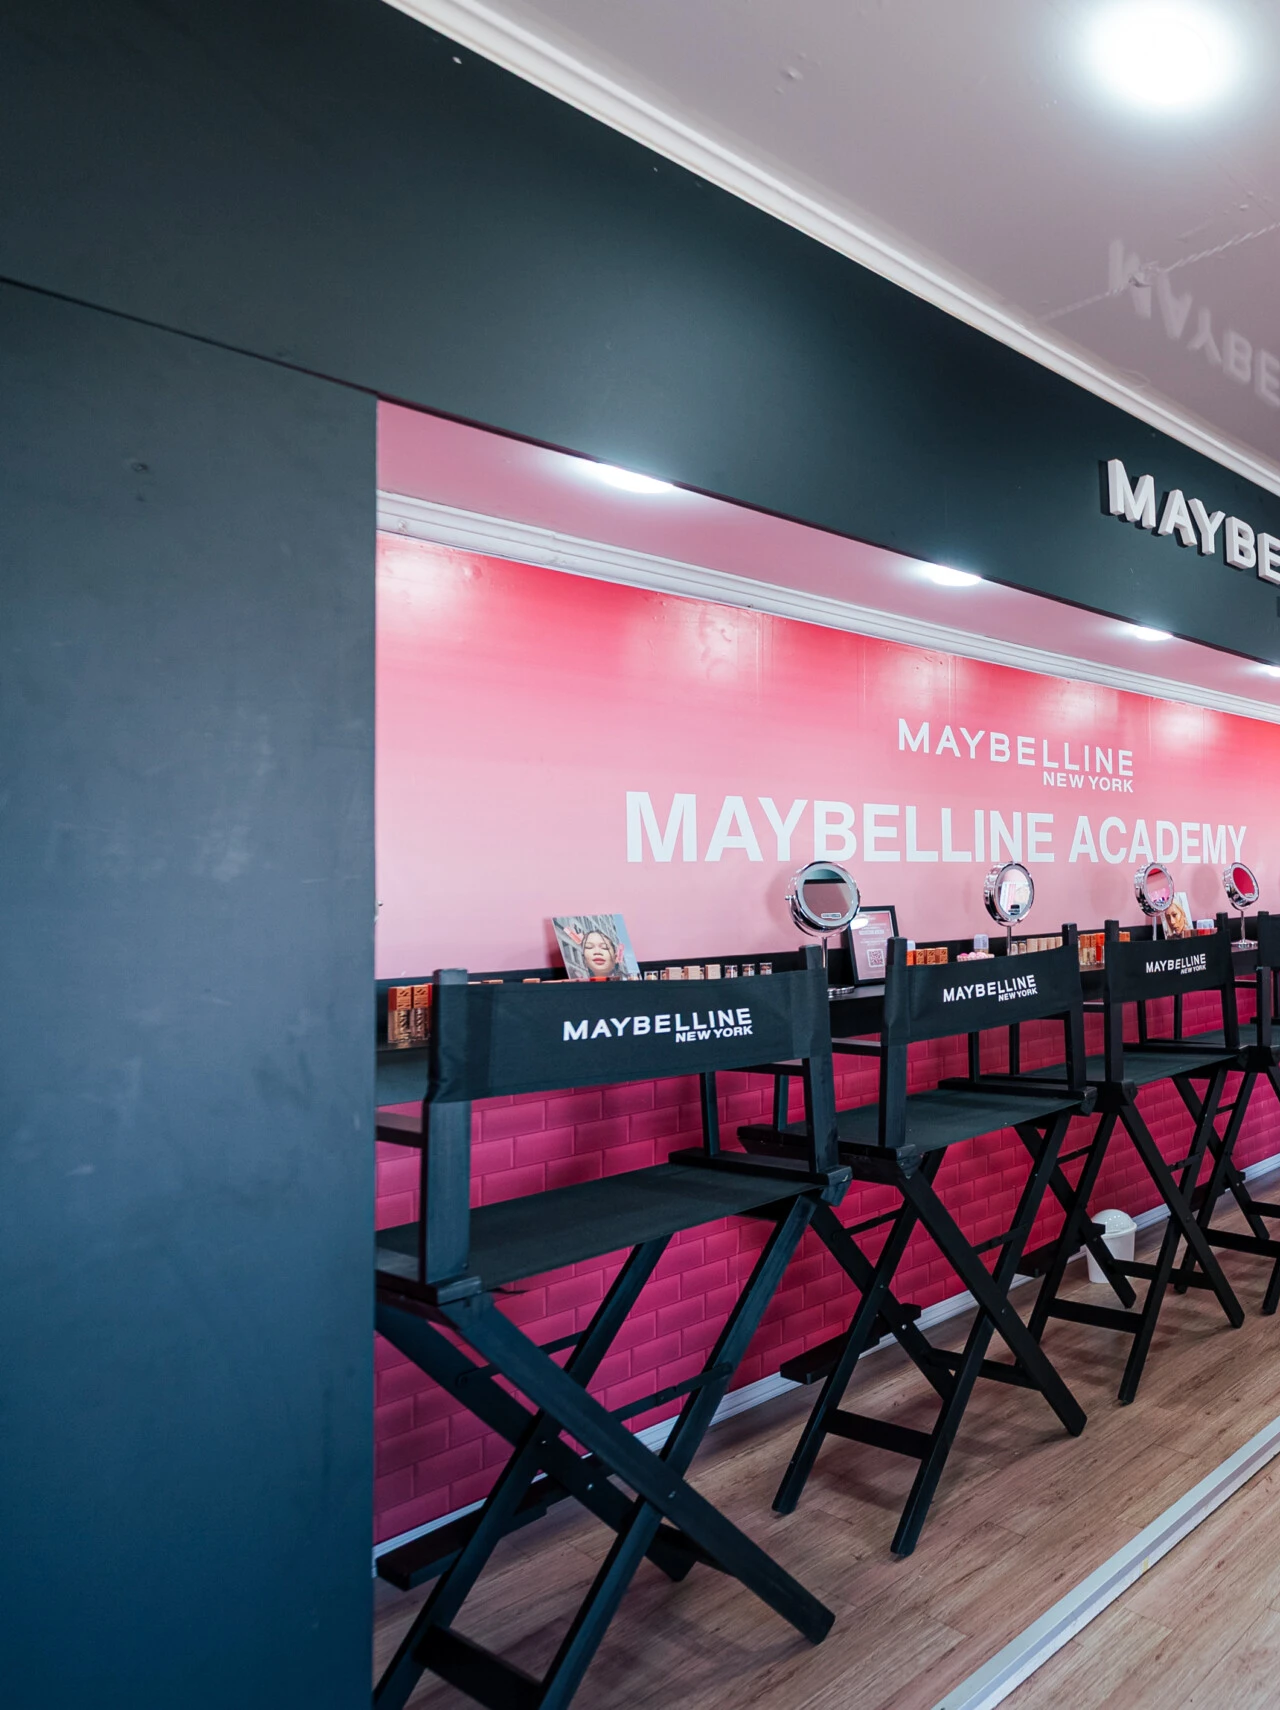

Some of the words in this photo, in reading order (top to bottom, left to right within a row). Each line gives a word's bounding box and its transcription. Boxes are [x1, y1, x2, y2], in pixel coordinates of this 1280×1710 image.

[898, 718, 1133, 776] MAYBELLINE
[1042, 770, 1084, 788] NEW
[1088, 774, 1133, 793] YORK
[626, 790, 1055, 862] MAYBELLINE
[1068, 815, 1246, 864] ACADEMY
[1146, 953, 1206, 973] MAYBELLINE
[1180, 966, 1193, 975] NEW
[1193, 964, 1206, 972] YORK
[943, 974, 1036, 1002] MAYBELLINE
[998, 991, 1016, 1002] NEW
[1016, 987, 1038, 998] YORK
[563, 1008, 752, 1041] MAYBELLINE
[675, 1030, 710, 1043] NEW
[713, 1025, 753, 1039] YORK
